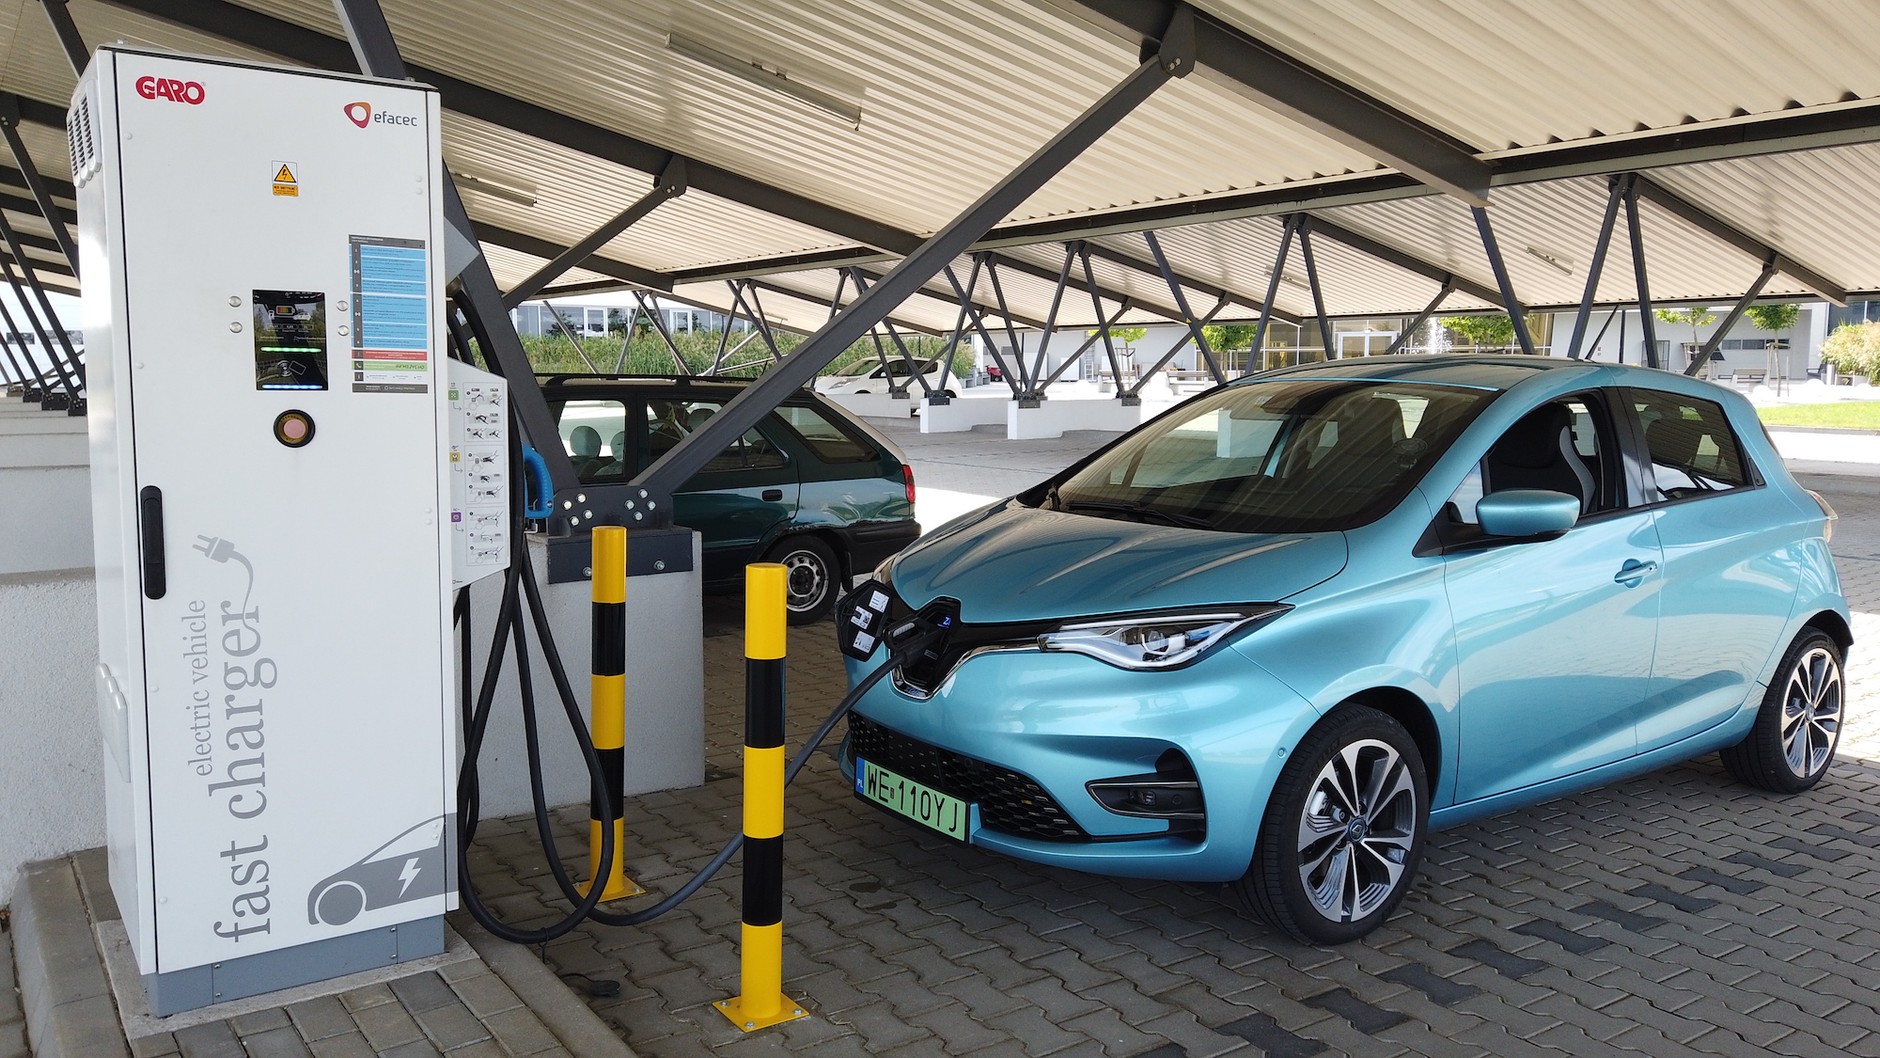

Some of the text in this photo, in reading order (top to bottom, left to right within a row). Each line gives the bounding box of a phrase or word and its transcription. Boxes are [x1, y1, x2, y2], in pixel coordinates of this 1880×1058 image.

[135, 75, 206, 105] GARO
[374, 111, 418, 127] efacec
[181, 599, 213, 776] electric vehicle
[208, 600, 278, 943] fast charger
[867, 764, 958, 833] WE 110YJ
